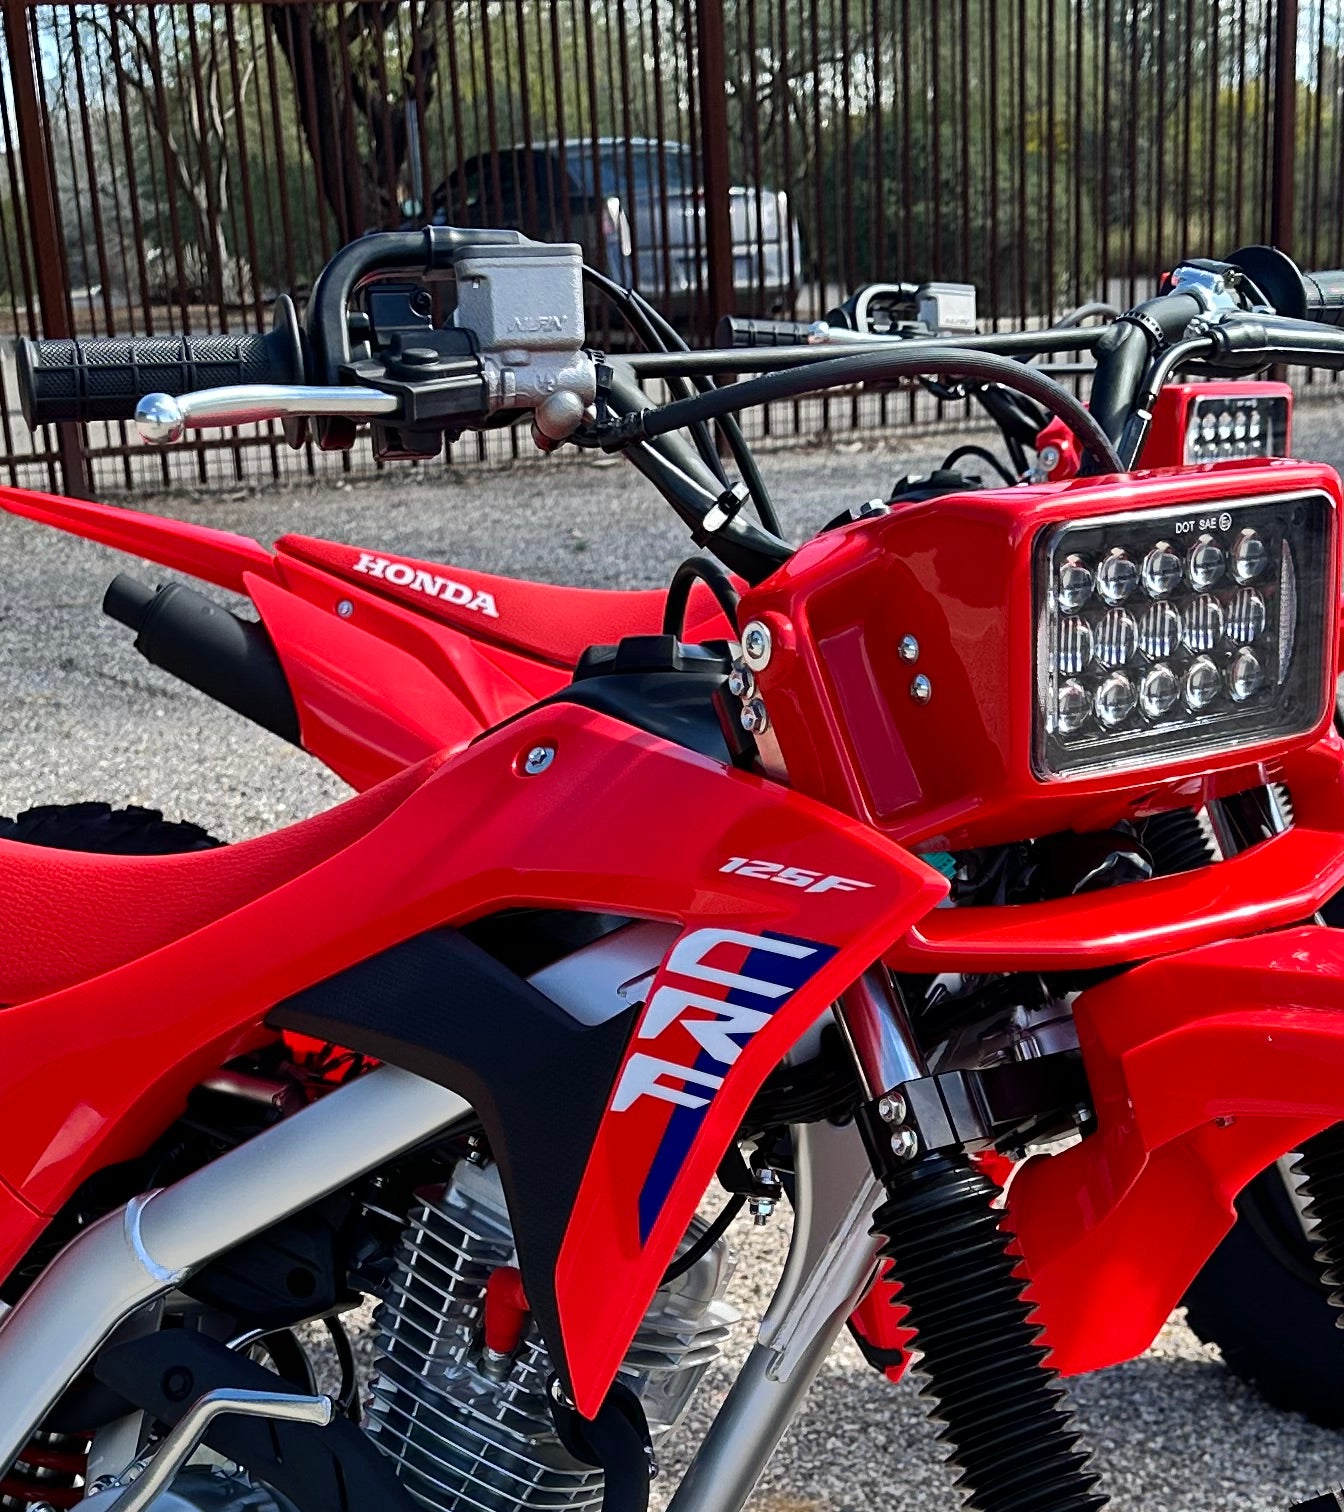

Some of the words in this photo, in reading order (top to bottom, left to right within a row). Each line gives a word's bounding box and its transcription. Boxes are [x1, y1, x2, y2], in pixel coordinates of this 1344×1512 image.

[1175, 520, 1196, 534] DOT
[1199, 517, 1217, 531] SAE
[353, 553, 499, 619] HONDA
[718, 857, 876, 893] 125F
[610, 927, 818, 1112] CRF
